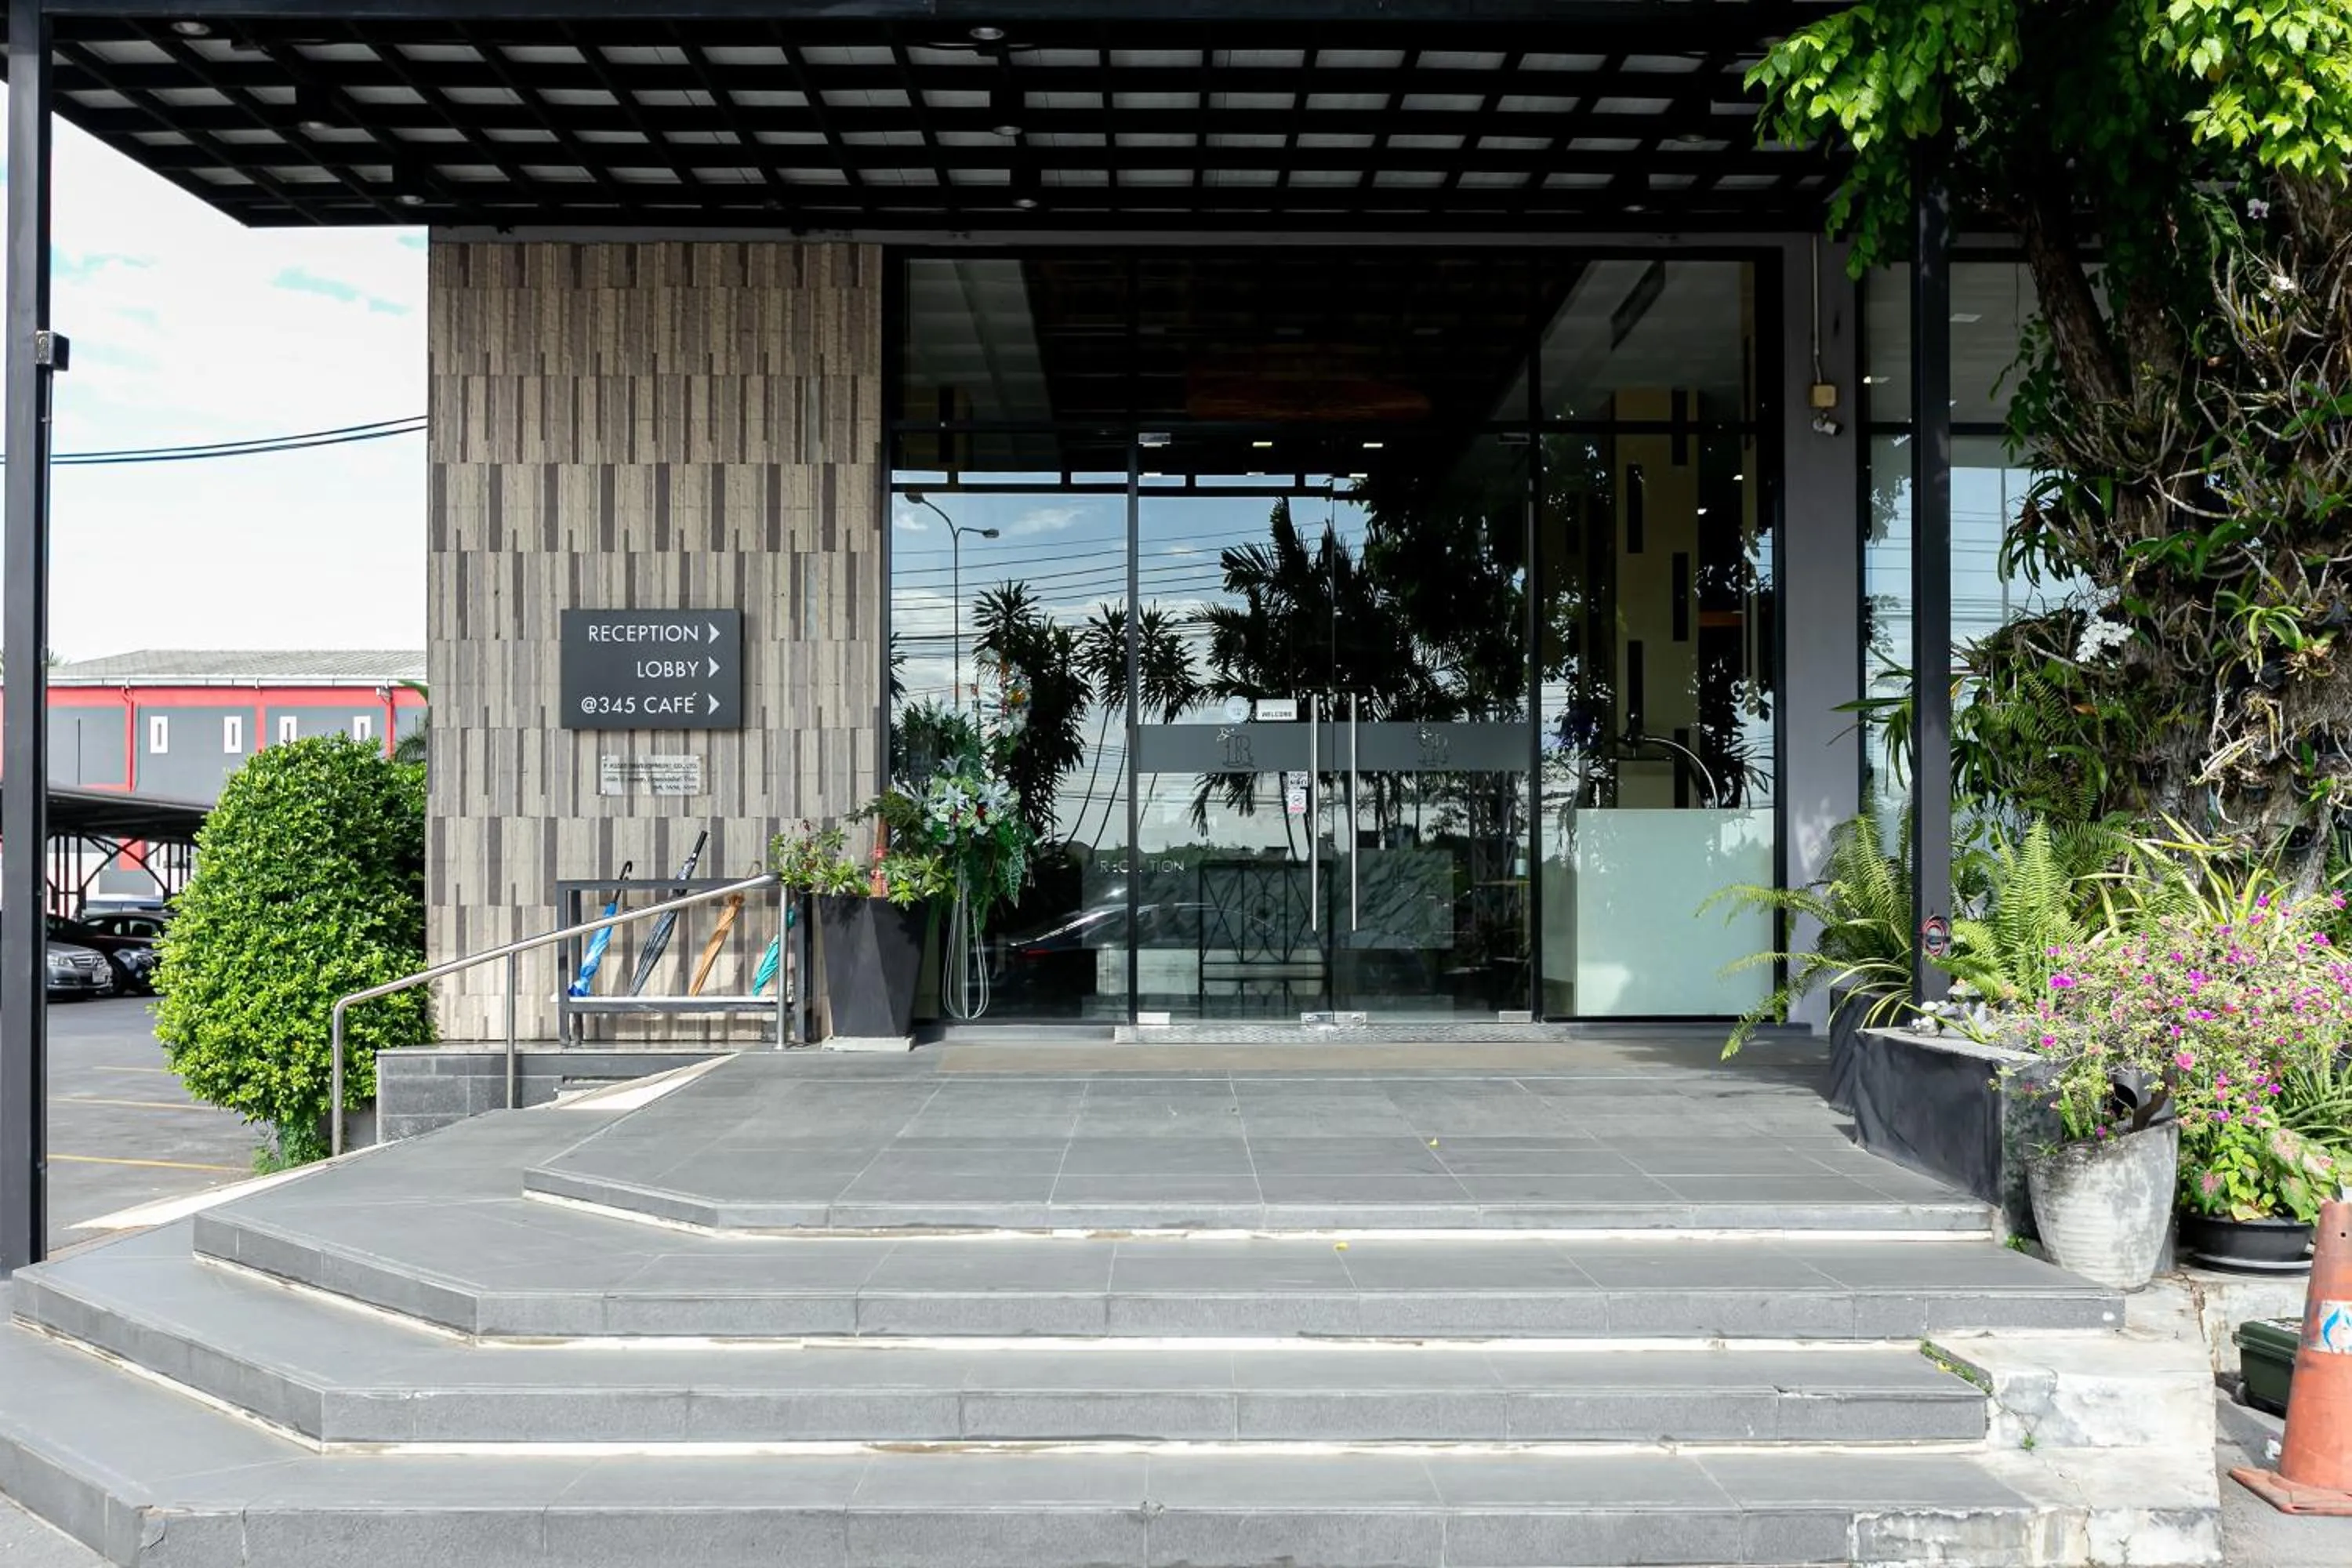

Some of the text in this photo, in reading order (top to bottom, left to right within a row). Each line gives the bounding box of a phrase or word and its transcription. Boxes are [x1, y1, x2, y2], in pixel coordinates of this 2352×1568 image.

[588, 625, 699, 642] RECEPTION
[637, 661, 699, 678] LOBBY
[581, 692, 697, 714] @345 CAFÉ
